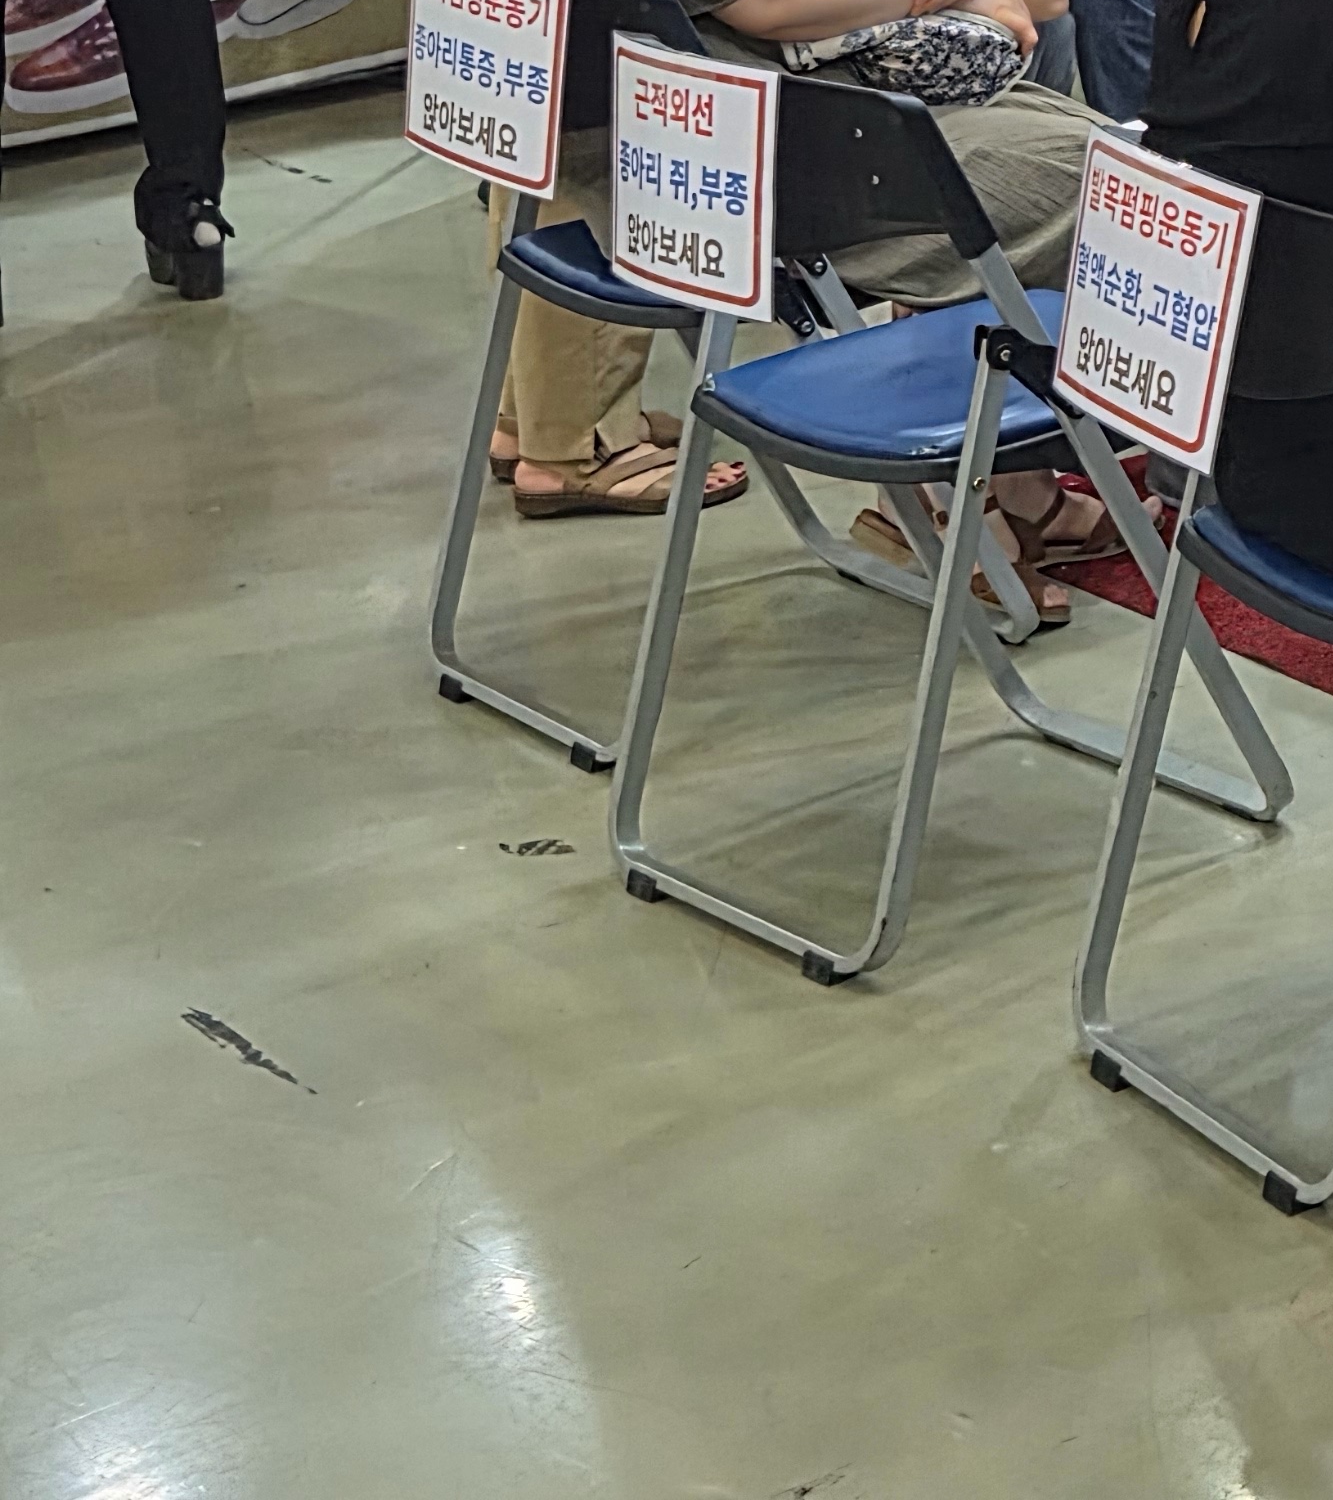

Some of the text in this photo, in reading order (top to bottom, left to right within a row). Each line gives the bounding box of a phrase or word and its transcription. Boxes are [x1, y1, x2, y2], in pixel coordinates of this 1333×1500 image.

[414, 22, 550, 106] 종아리통증,부종
[422, 92, 518, 163] 앉아보세요
[634, 77, 714, 138] 근적외선
[618, 139, 749, 217] 종아리 쥐,부종
[1088, 166, 1231, 270] 발목펌핑운동기
[627, 213, 726, 279] 앉아보세요
[1077, 240, 1219, 353] 혈액순환,고혈압
[1078, 325, 1178, 417] 앉아보세요
